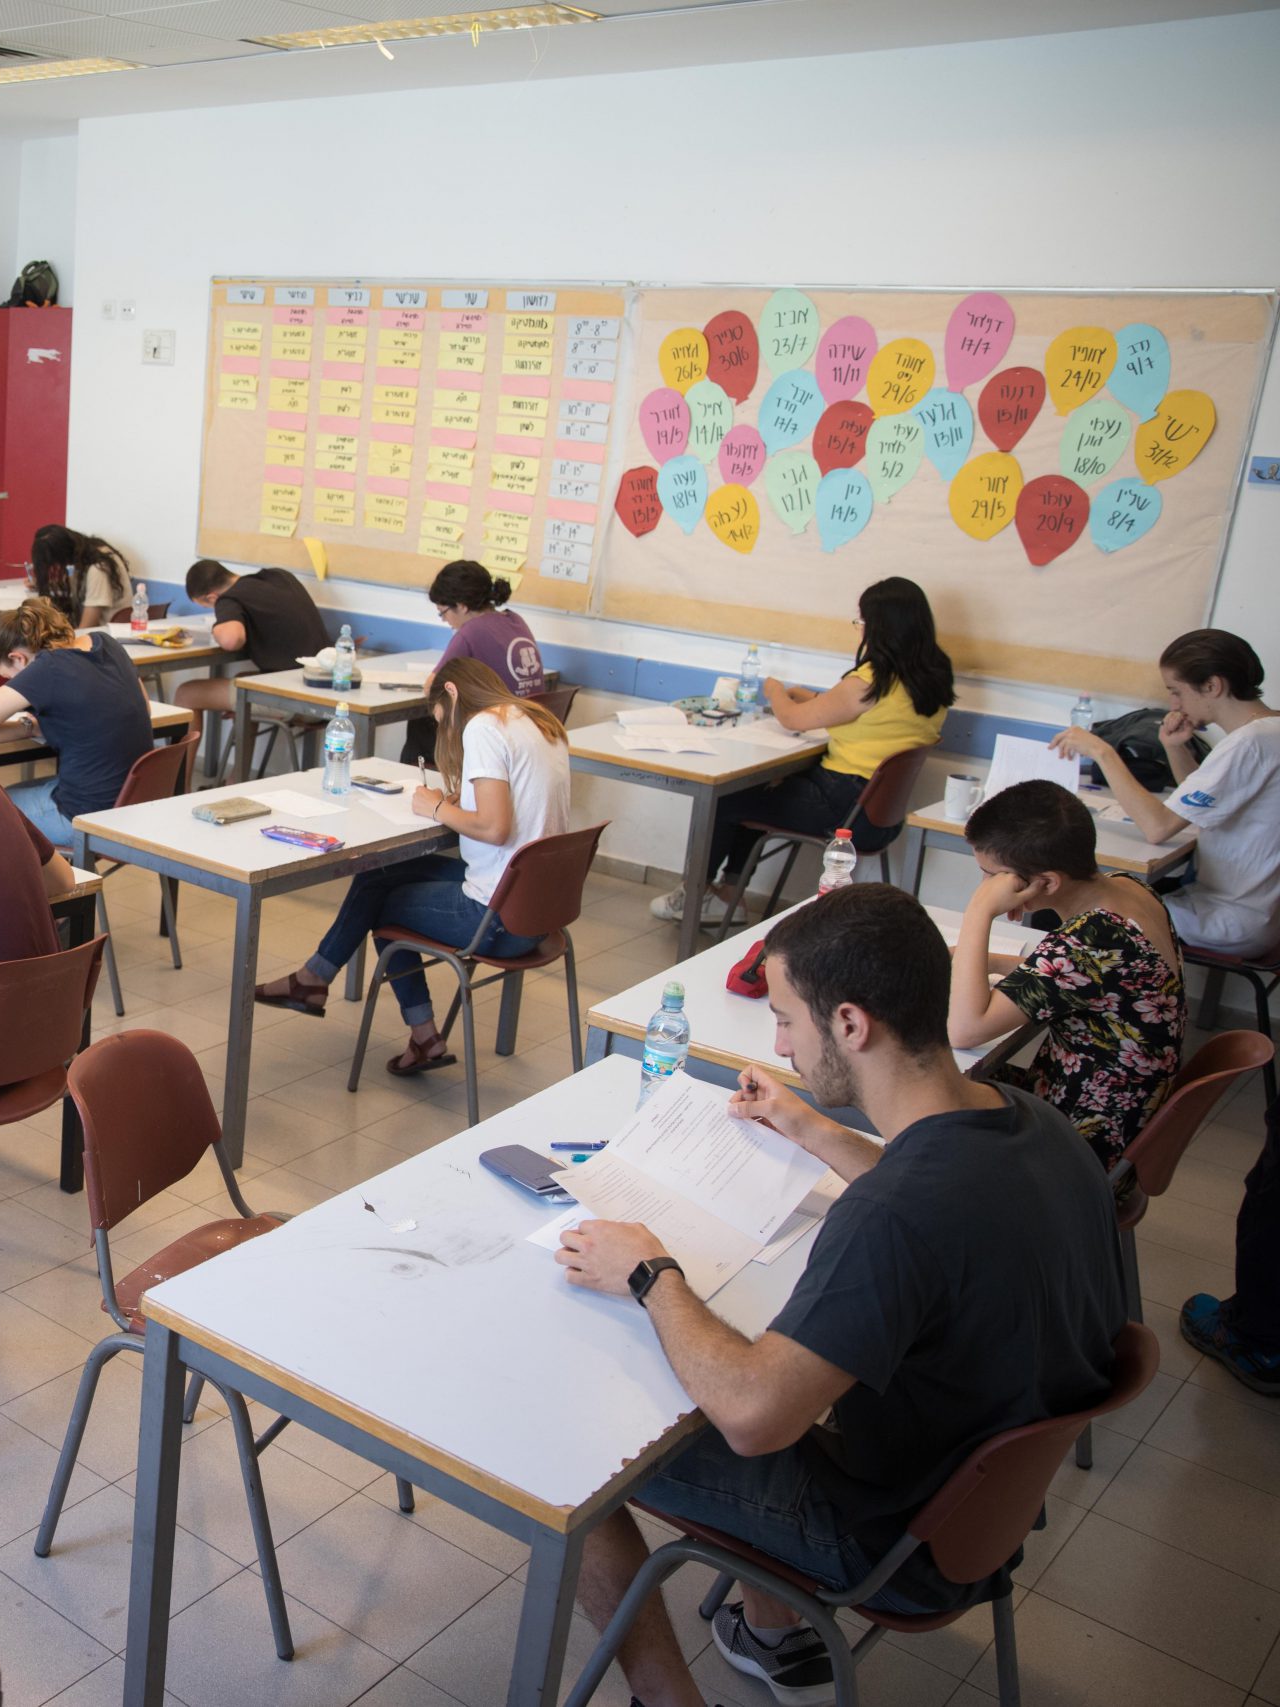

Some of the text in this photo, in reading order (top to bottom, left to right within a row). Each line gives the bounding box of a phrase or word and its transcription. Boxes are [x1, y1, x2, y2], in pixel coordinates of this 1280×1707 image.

[465, 292, 478, 306] שני
[774, 308, 809, 328] אביב
[967, 312, 1005, 334] דניאל
[772, 334, 808, 356] 23/7
[828, 344, 866, 361] שירה
[960, 336, 992, 356] 17/7
[1070, 345, 1107, 365] אופיר
[1127, 339, 1150, 356] נדב
[718, 345, 750, 372] 30/6
[895, 352, 926, 373] אוהד
[1126, 357, 1155, 375] 9/7
[675, 361, 702, 383] 26/5
[832, 364, 861, 385] 11/11
[1061, 368, 1102, 392] 24/12
[881, 381, 918, 404] 29/6
[1000, 385, 1035, 401] רננה
[916, 402, 957, 427] גלעד
[997, 405, 1028, 425] 15/11
[656, 425, 684, 445] 19/5
[773, 416, 798, 434] 17/7
[893, 424, 919, 442] נעמי
[1090, 417, 1122, 440] נעמי
[1165, 415, 1200, 442] ישי
[828, 435, 857, 454] 15/4
[934, 427, 963, 448] 13/11
[1144, 440, 1179, 469] 31/12
[731, 461, 753, 476] 13/3
[881, 461, 904, 479] 5/2
[1073, 456, 1106, 476] 18/10
[673, 470, 697, 487] נועה
[979, 476, 1009, 493] אורי
[672, 489, 698, 510] 18/9
[781, 487, 811, 513] 12/1
[845, 484, 862, 501] רון
[632, 507, 658, 524] 13/3
[831, 504, 858, 522] 14/5
[971, 498, 1007, 521] 29/5
[1036, 510, 1074, 533] 20/9
[1107, 509, 1136, 532] 8/4
